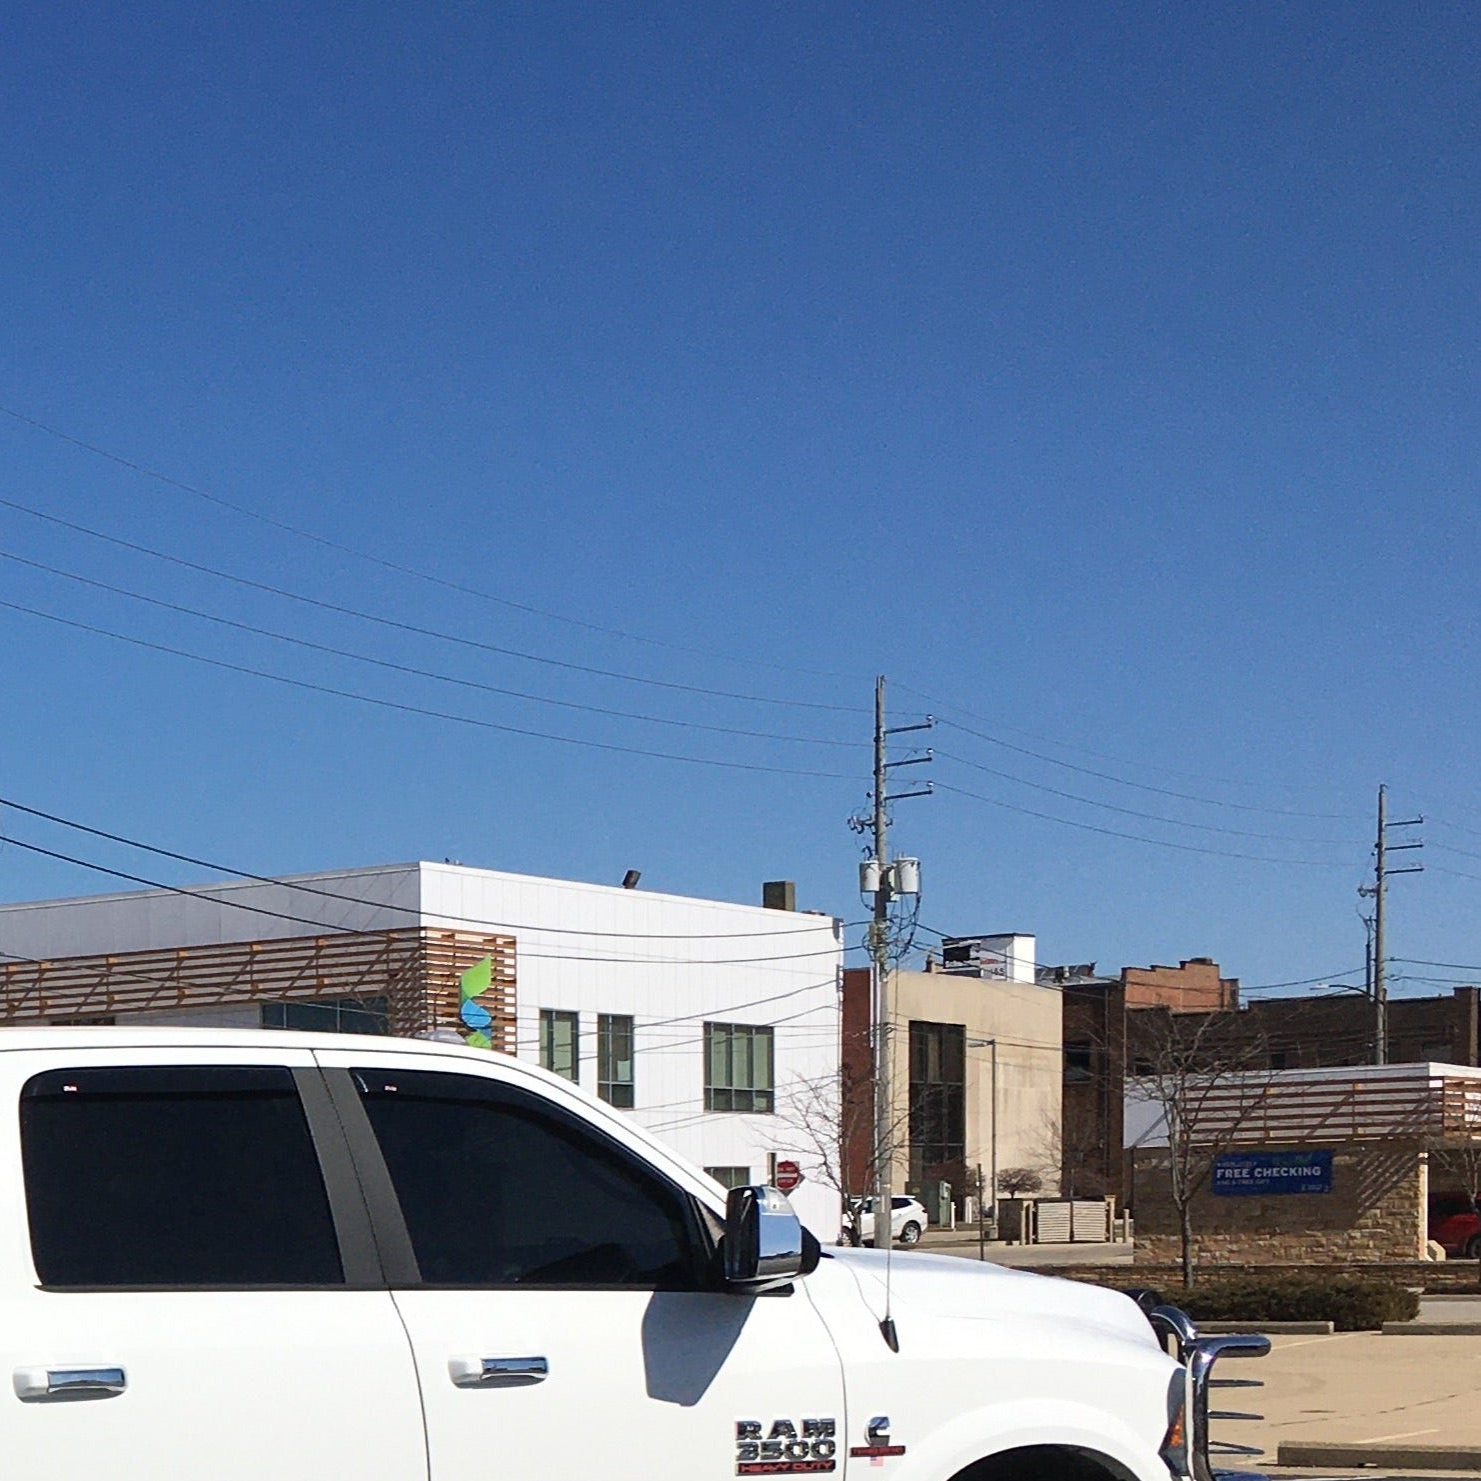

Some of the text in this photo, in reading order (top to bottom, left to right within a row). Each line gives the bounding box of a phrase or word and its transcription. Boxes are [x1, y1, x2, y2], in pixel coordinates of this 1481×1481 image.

[1216, 1166, 1321, 1179] FREE CHECKING
[735, 1418, 835, 1440] RAM
[741, 1461, 833, 1472] HEAVY DUTY
